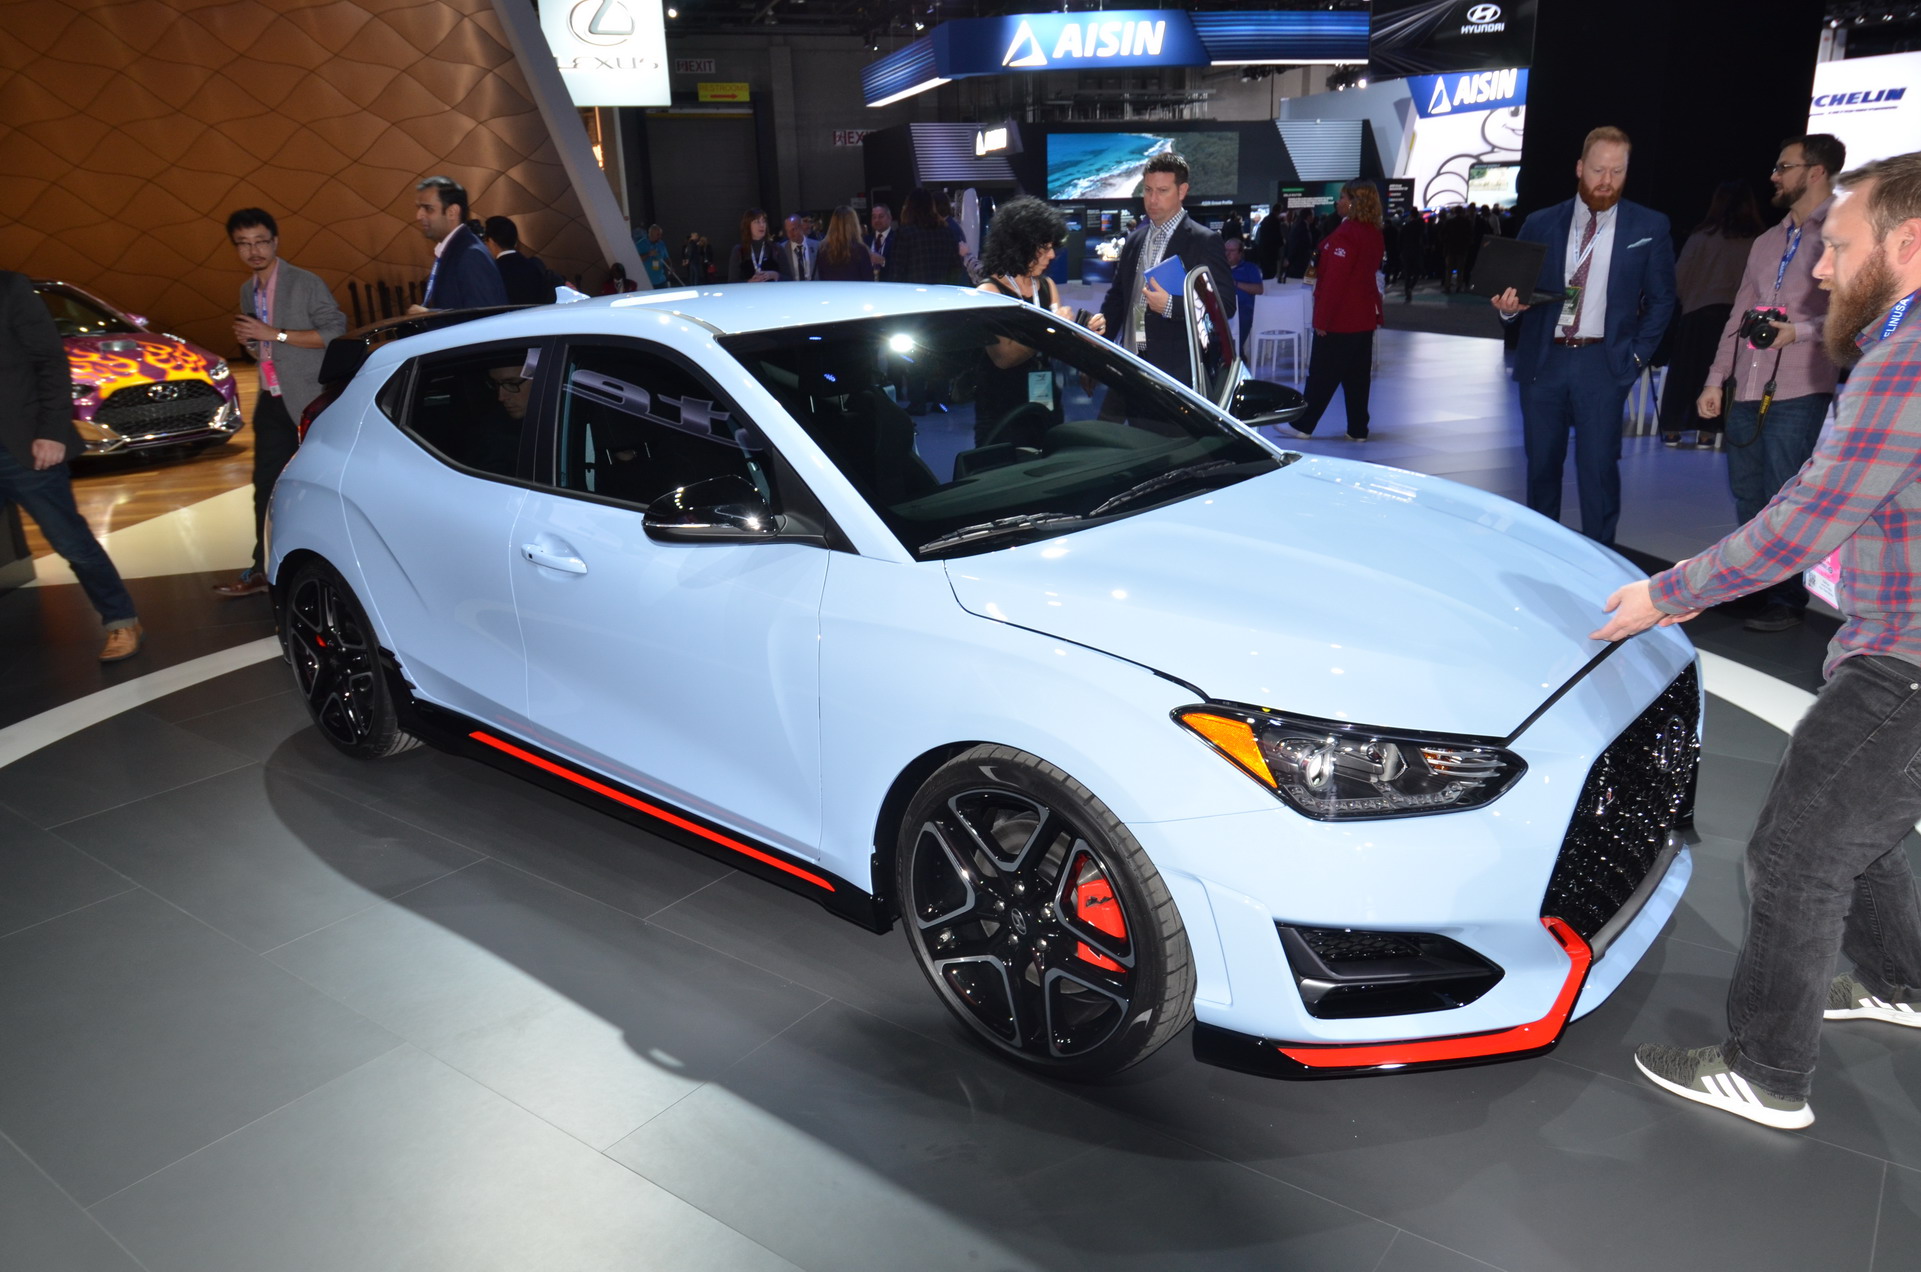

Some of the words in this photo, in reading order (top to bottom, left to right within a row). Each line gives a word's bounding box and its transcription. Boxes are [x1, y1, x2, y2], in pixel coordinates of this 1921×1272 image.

[1052, 20, 1166, 59] AISIN
[1460, 22, 1505, 35] HYUNDAI
[688, 60, 713, 73] EXIT
[1452, 67, 1518, 107] AISIN
[1882, 298, 1910, 340] ELINUSA
